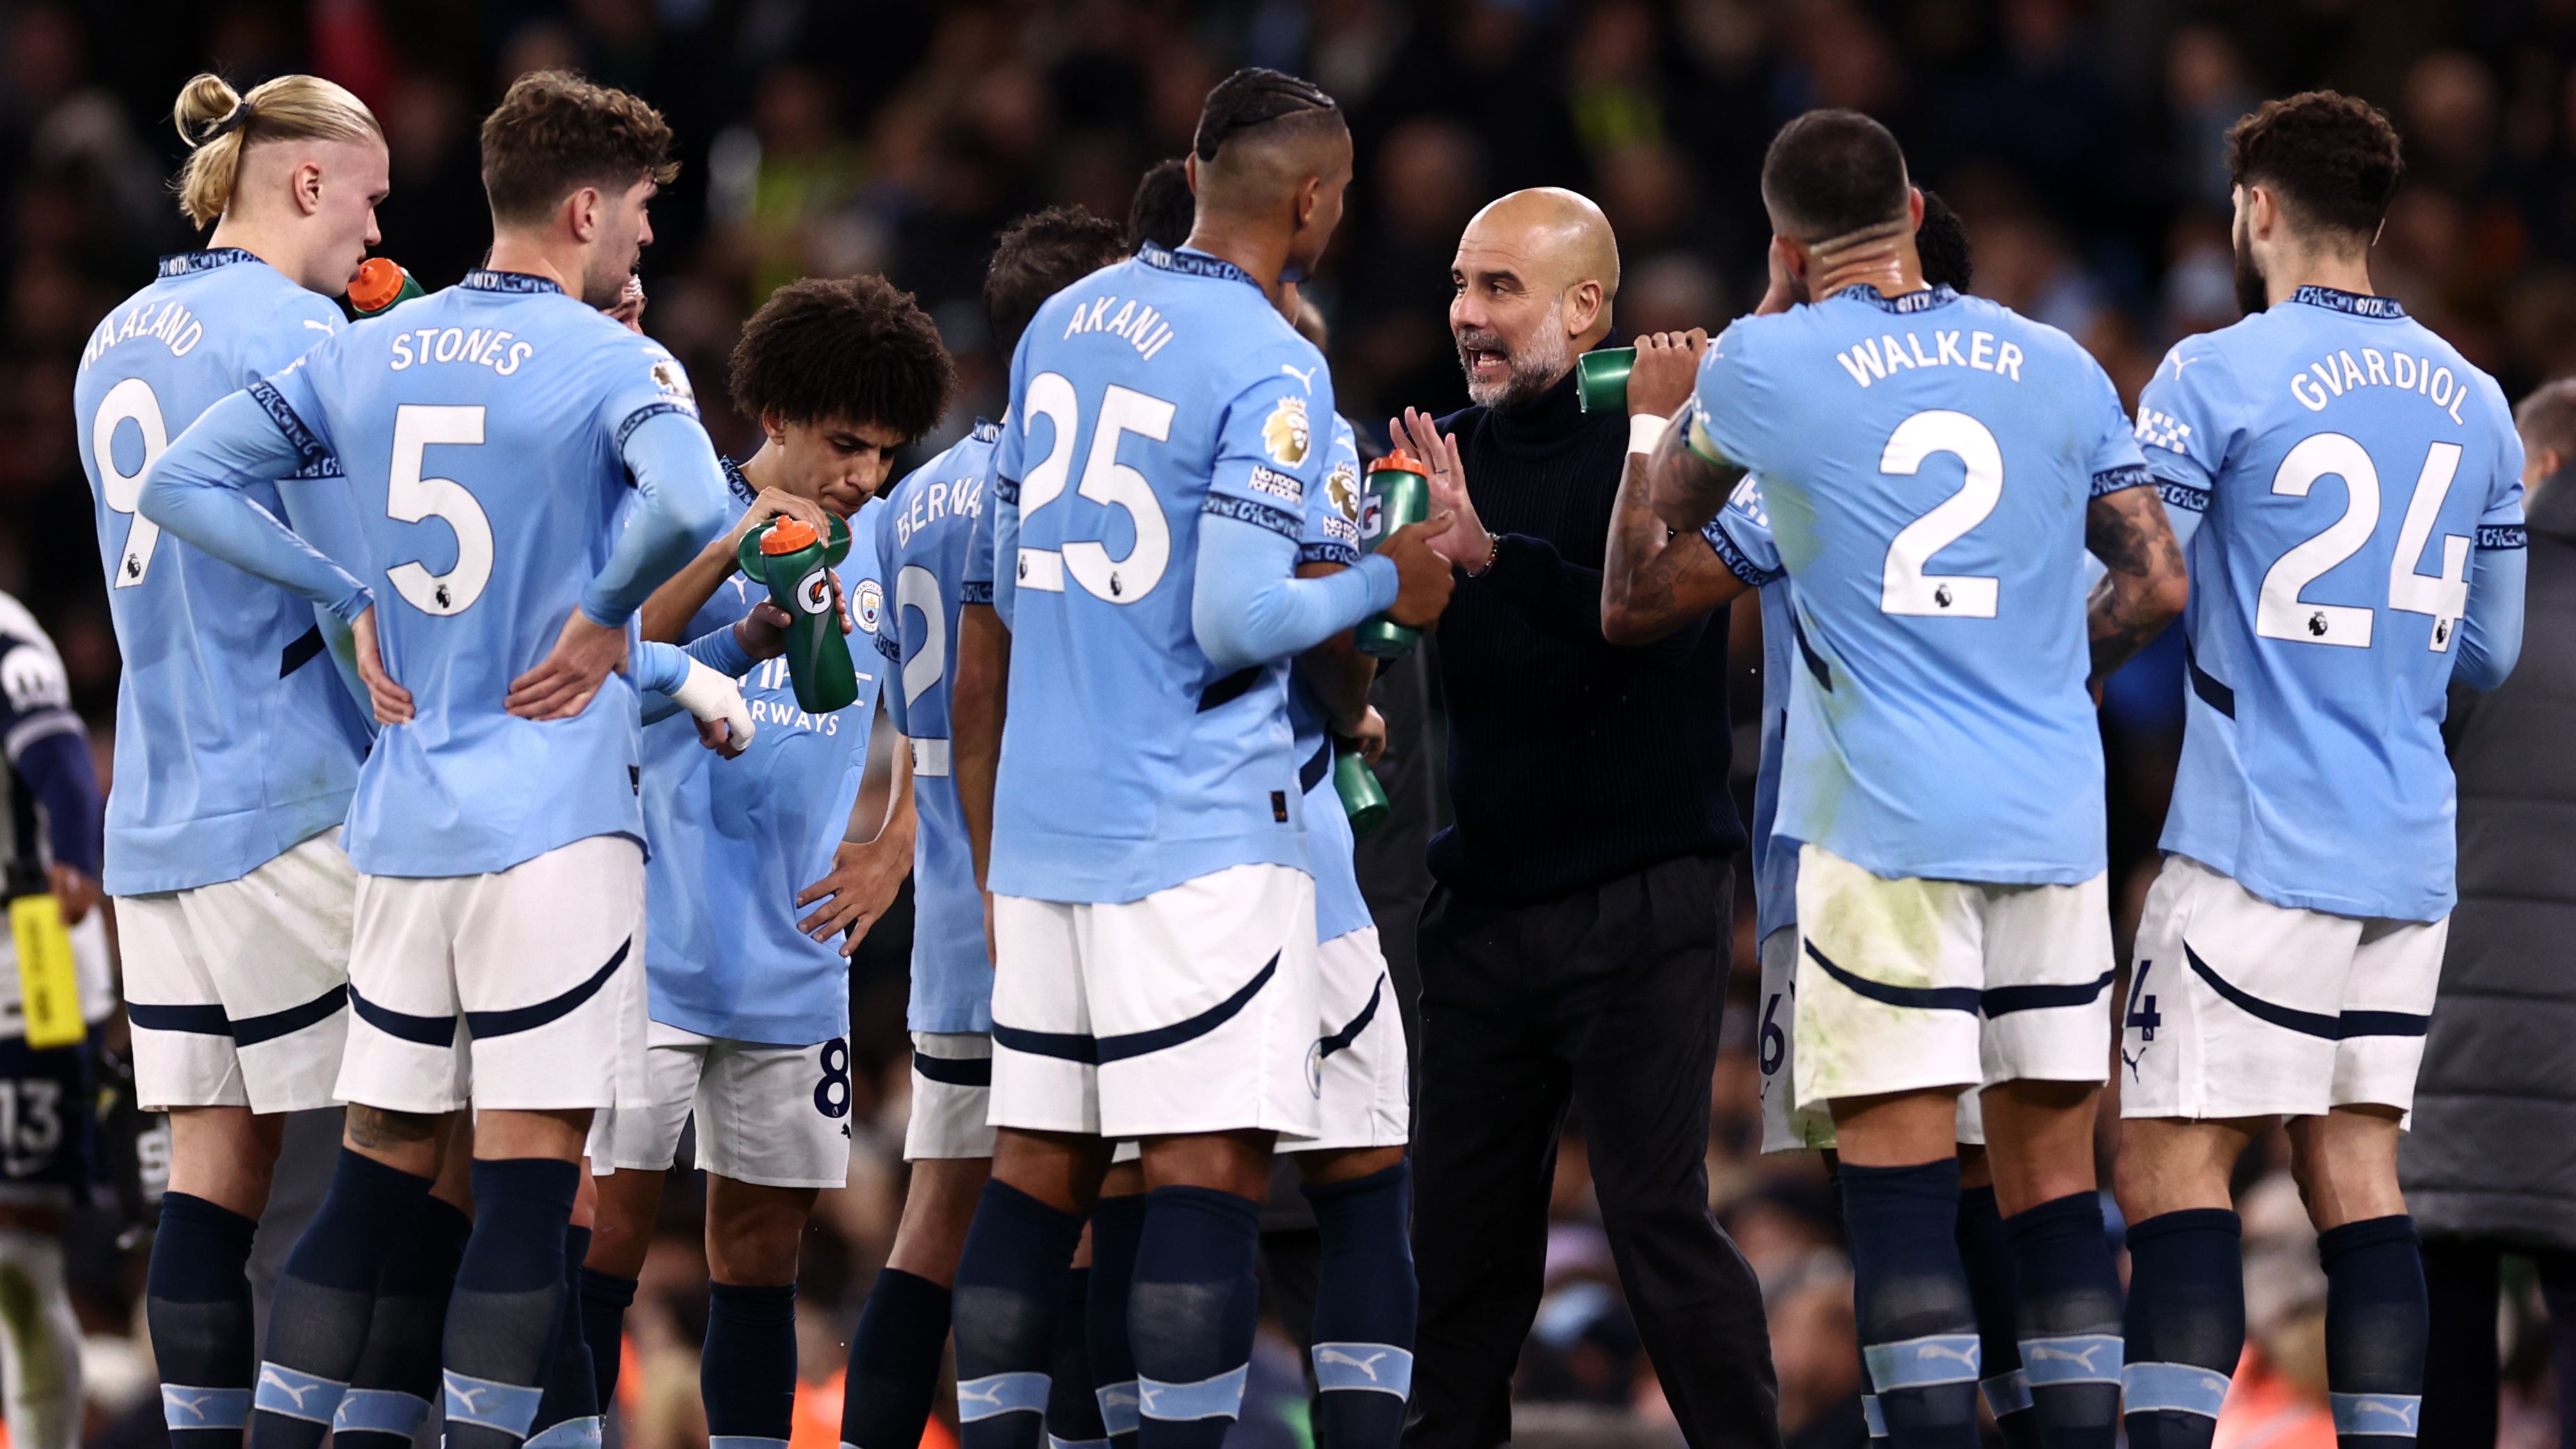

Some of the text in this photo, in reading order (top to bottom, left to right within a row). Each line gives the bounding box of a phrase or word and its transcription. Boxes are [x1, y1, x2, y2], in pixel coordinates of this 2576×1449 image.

[84, 301, 203, 373] HAALAND
[1064, 295, 1174, 361] AKANJI
[1897, 293, 1930, 312] CITY
[2356, 297, 2381, 316] CITY
[390, 327, 533, 376] STONES
[1836, 329, 2024, 388] WALKER
[2290, 349, 2468, 425] GVARDIOL
[93, 377, 167, 589] 9
[1017, 371, 1176, 604] 25
[1247, 480, 1270, 493] for
[1251, 465, 1273, 482] No
[386, 404, 494, 616] 5
[896, 477, 983, 550] BERNA
[1880, 409, 2003, 619] 2
[2256, 432, 2472, 653] 24
[796, 566, 832, 614] G
[855, 582, 883, 597] MANCHEST
[741, 698, 839, 737] RWAYS
[1760, 994, 1785, 1075] 6
[2126, 960, 2161, 1041] 4
[814, 1038, 851, 1118] 8
[0, 1079, 61, 1154] 13
